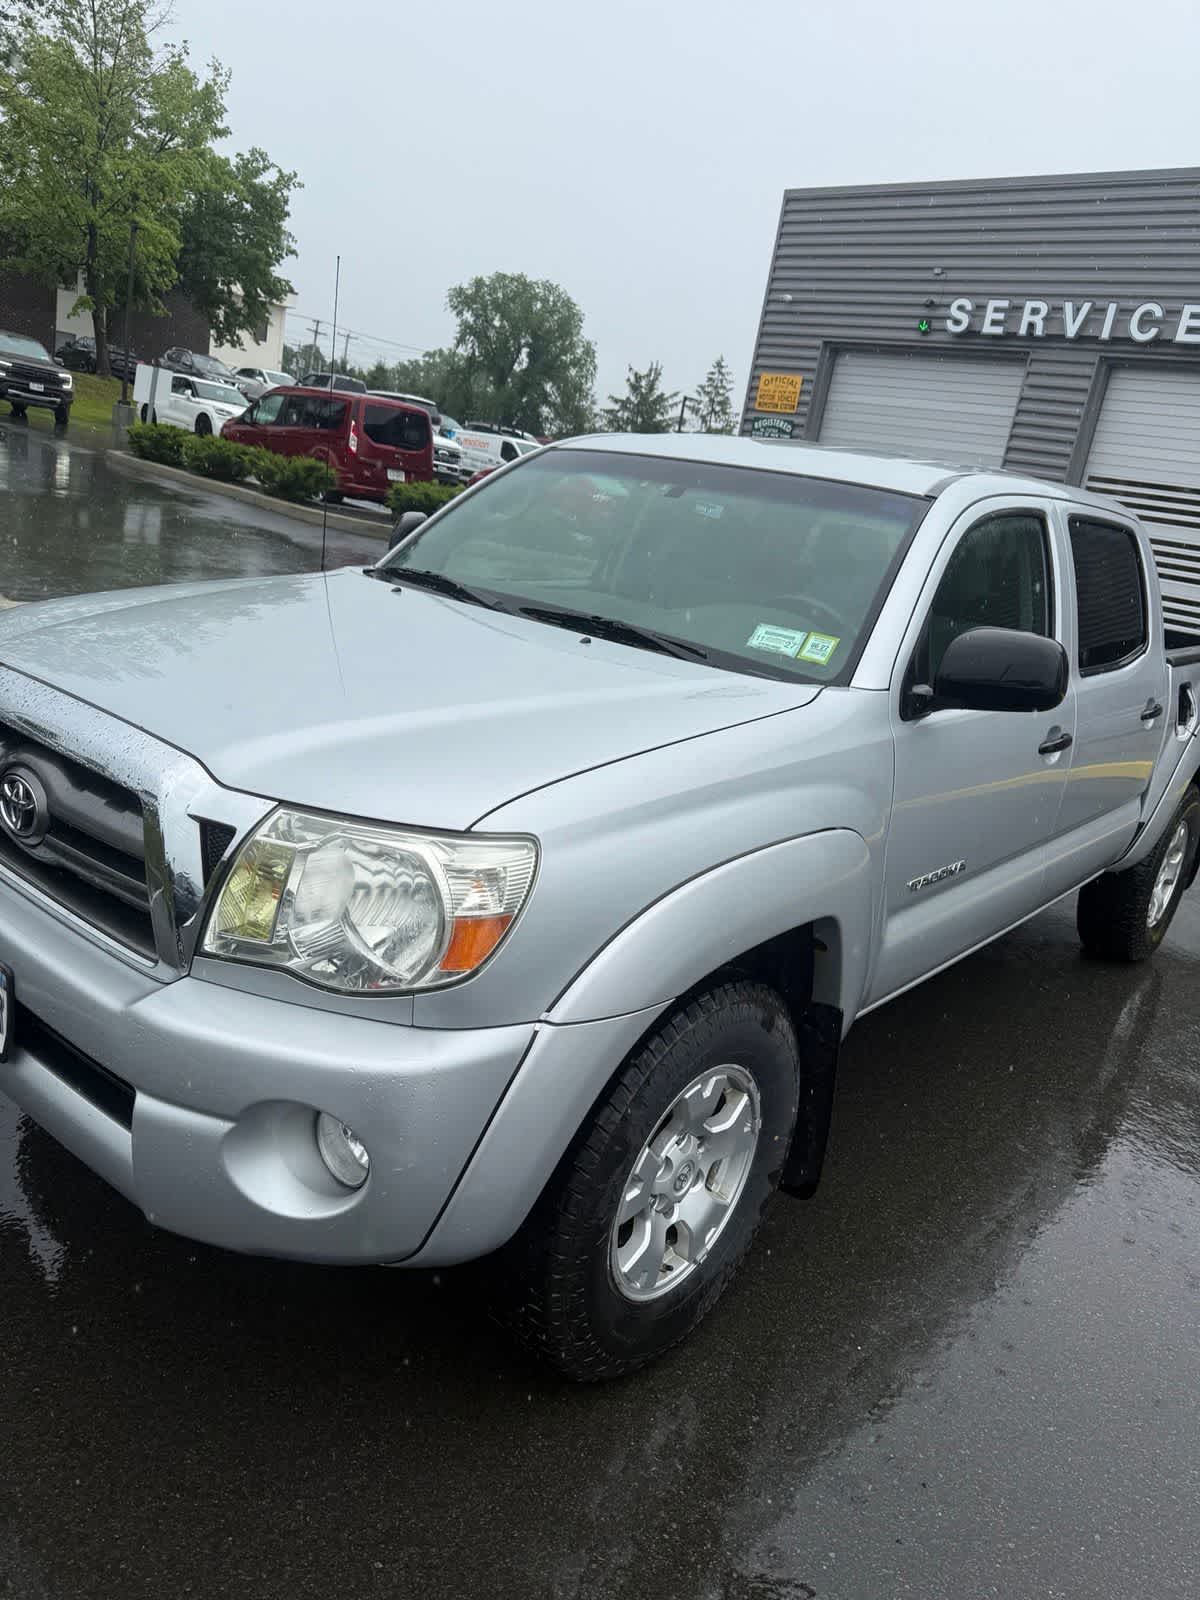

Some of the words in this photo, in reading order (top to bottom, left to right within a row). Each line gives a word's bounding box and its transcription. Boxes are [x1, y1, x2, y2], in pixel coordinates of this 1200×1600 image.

[945, 298, 1200, 343] SERVICE
[764, 376, 799, 388] OFFICIAL
[754, 418, 792, 432] REGISTERED
[908, 859, 967, 890] TACOMA
